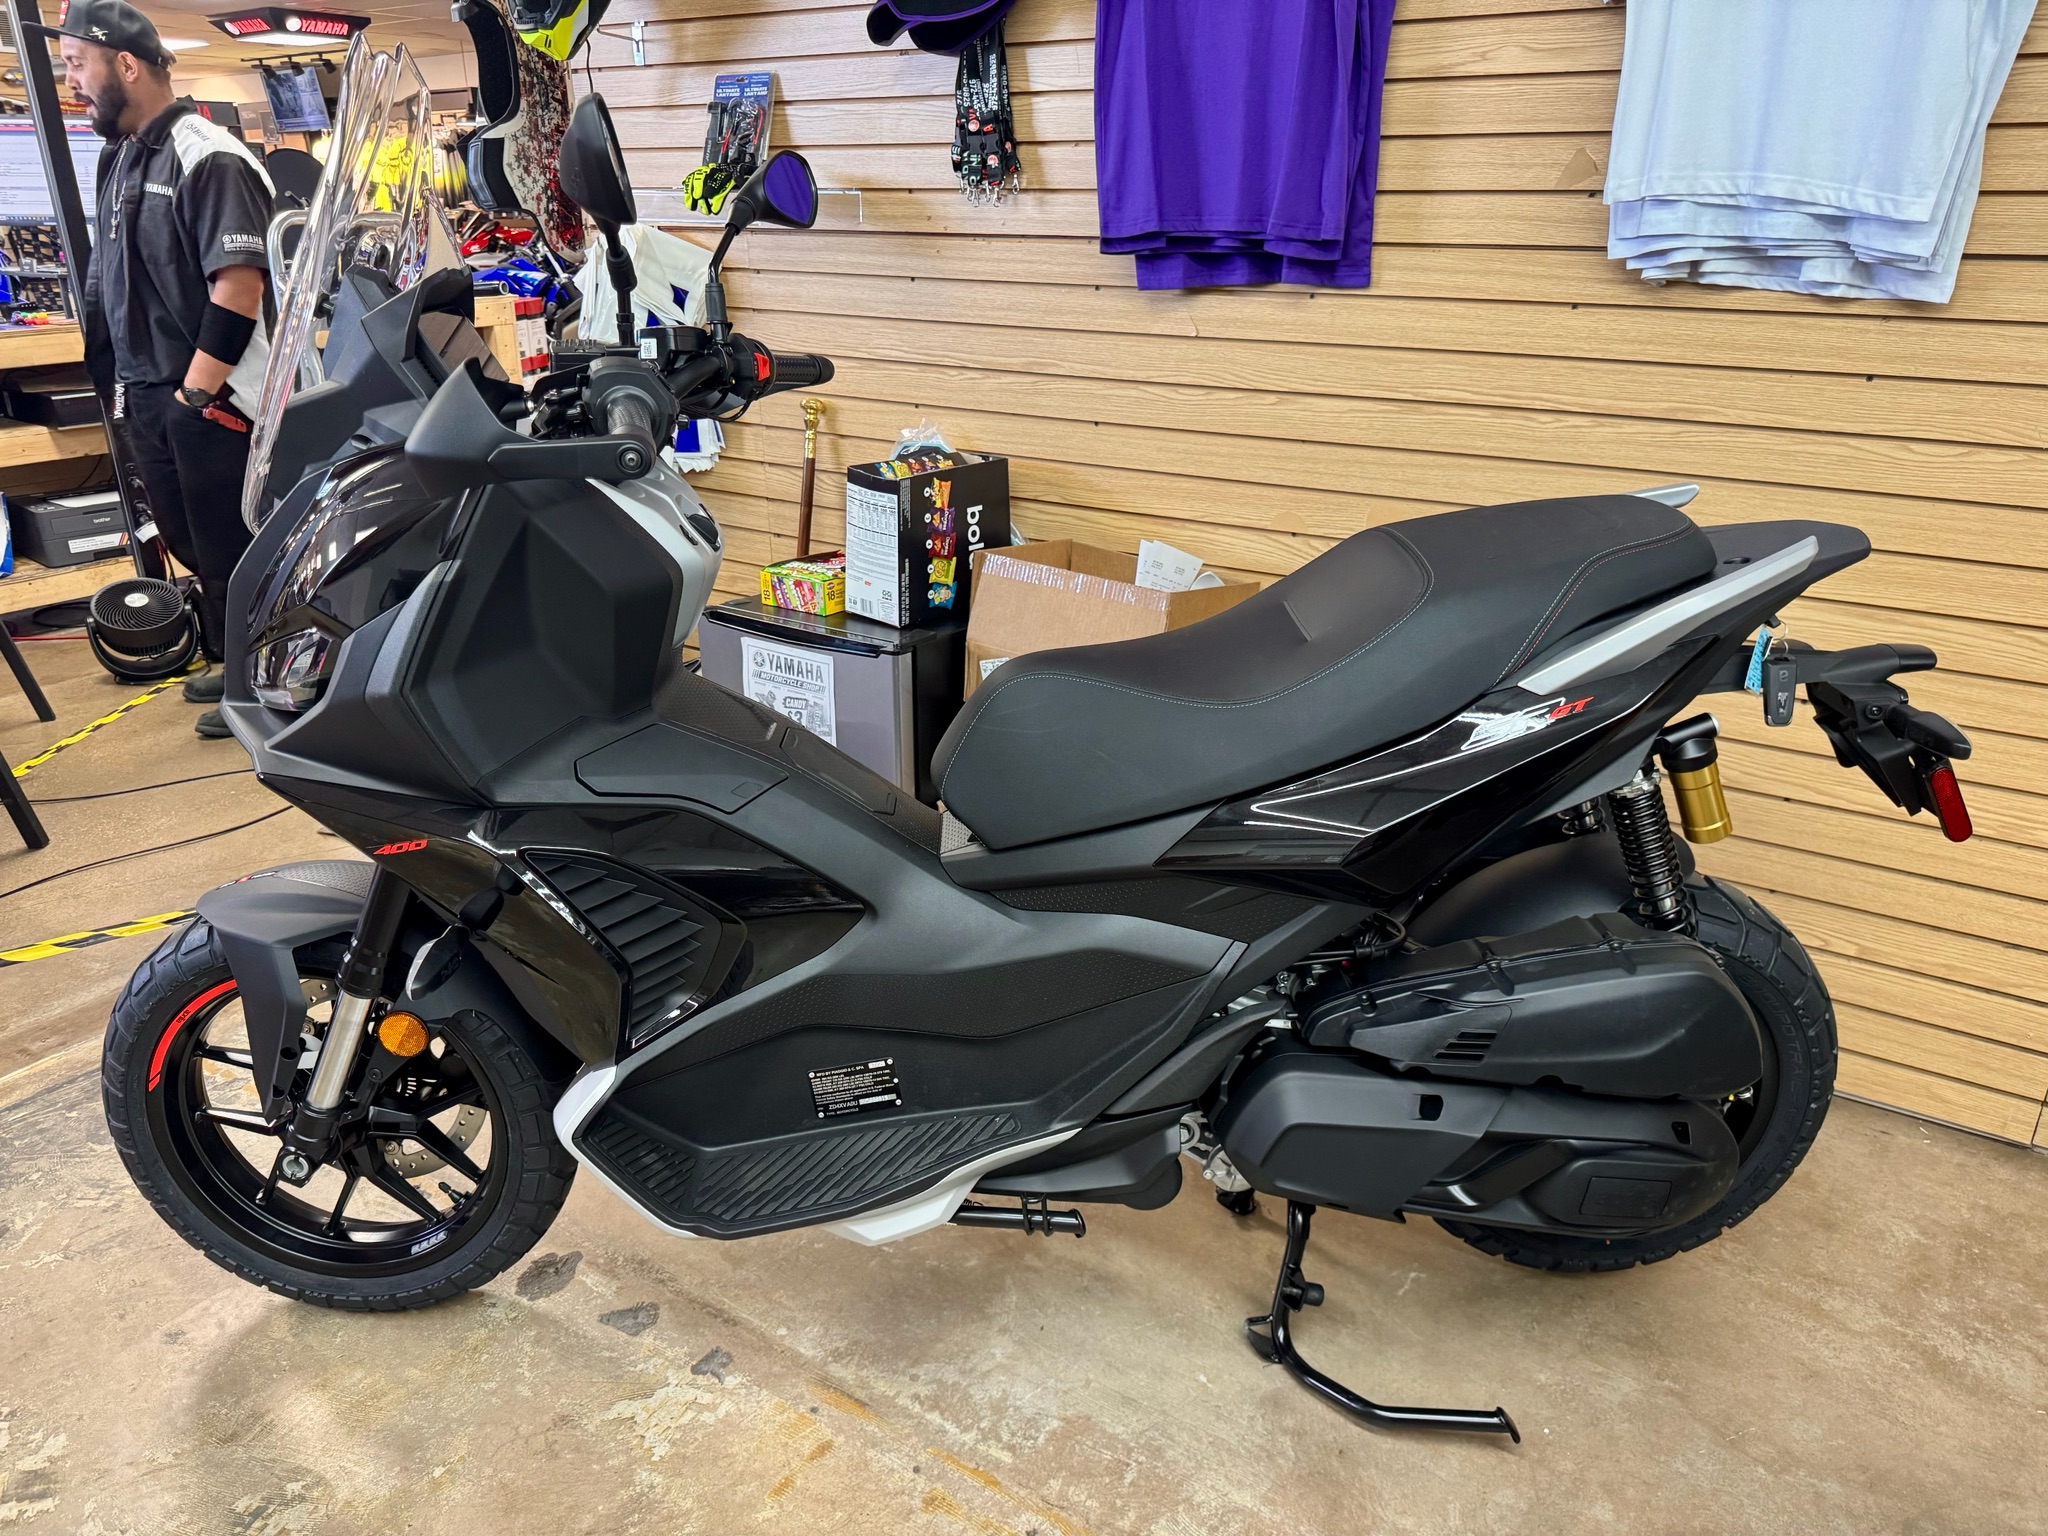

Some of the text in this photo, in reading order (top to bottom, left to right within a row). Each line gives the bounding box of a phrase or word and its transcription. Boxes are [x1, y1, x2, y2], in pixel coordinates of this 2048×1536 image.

[301, 18, 349, 35] YAMAHA
[145, 182, 173, 197] YAMAHA
[231, 233, 263, 245] YAMAHA
[763, 590, 771, 601] 18
[826, 590, 836, 602] 18
[766, 653, 824, 684] YAMAHA
[760, 671, 803, 687] MOTORCYCLE
[802, 682, 821, 692] SHOP
[785, 697, 807, 709] CANDY
[1549, 696, 1595, 721] GT
[373, 839, 428, 855] 400
[175, 1009, 191, 1024] aprilia
